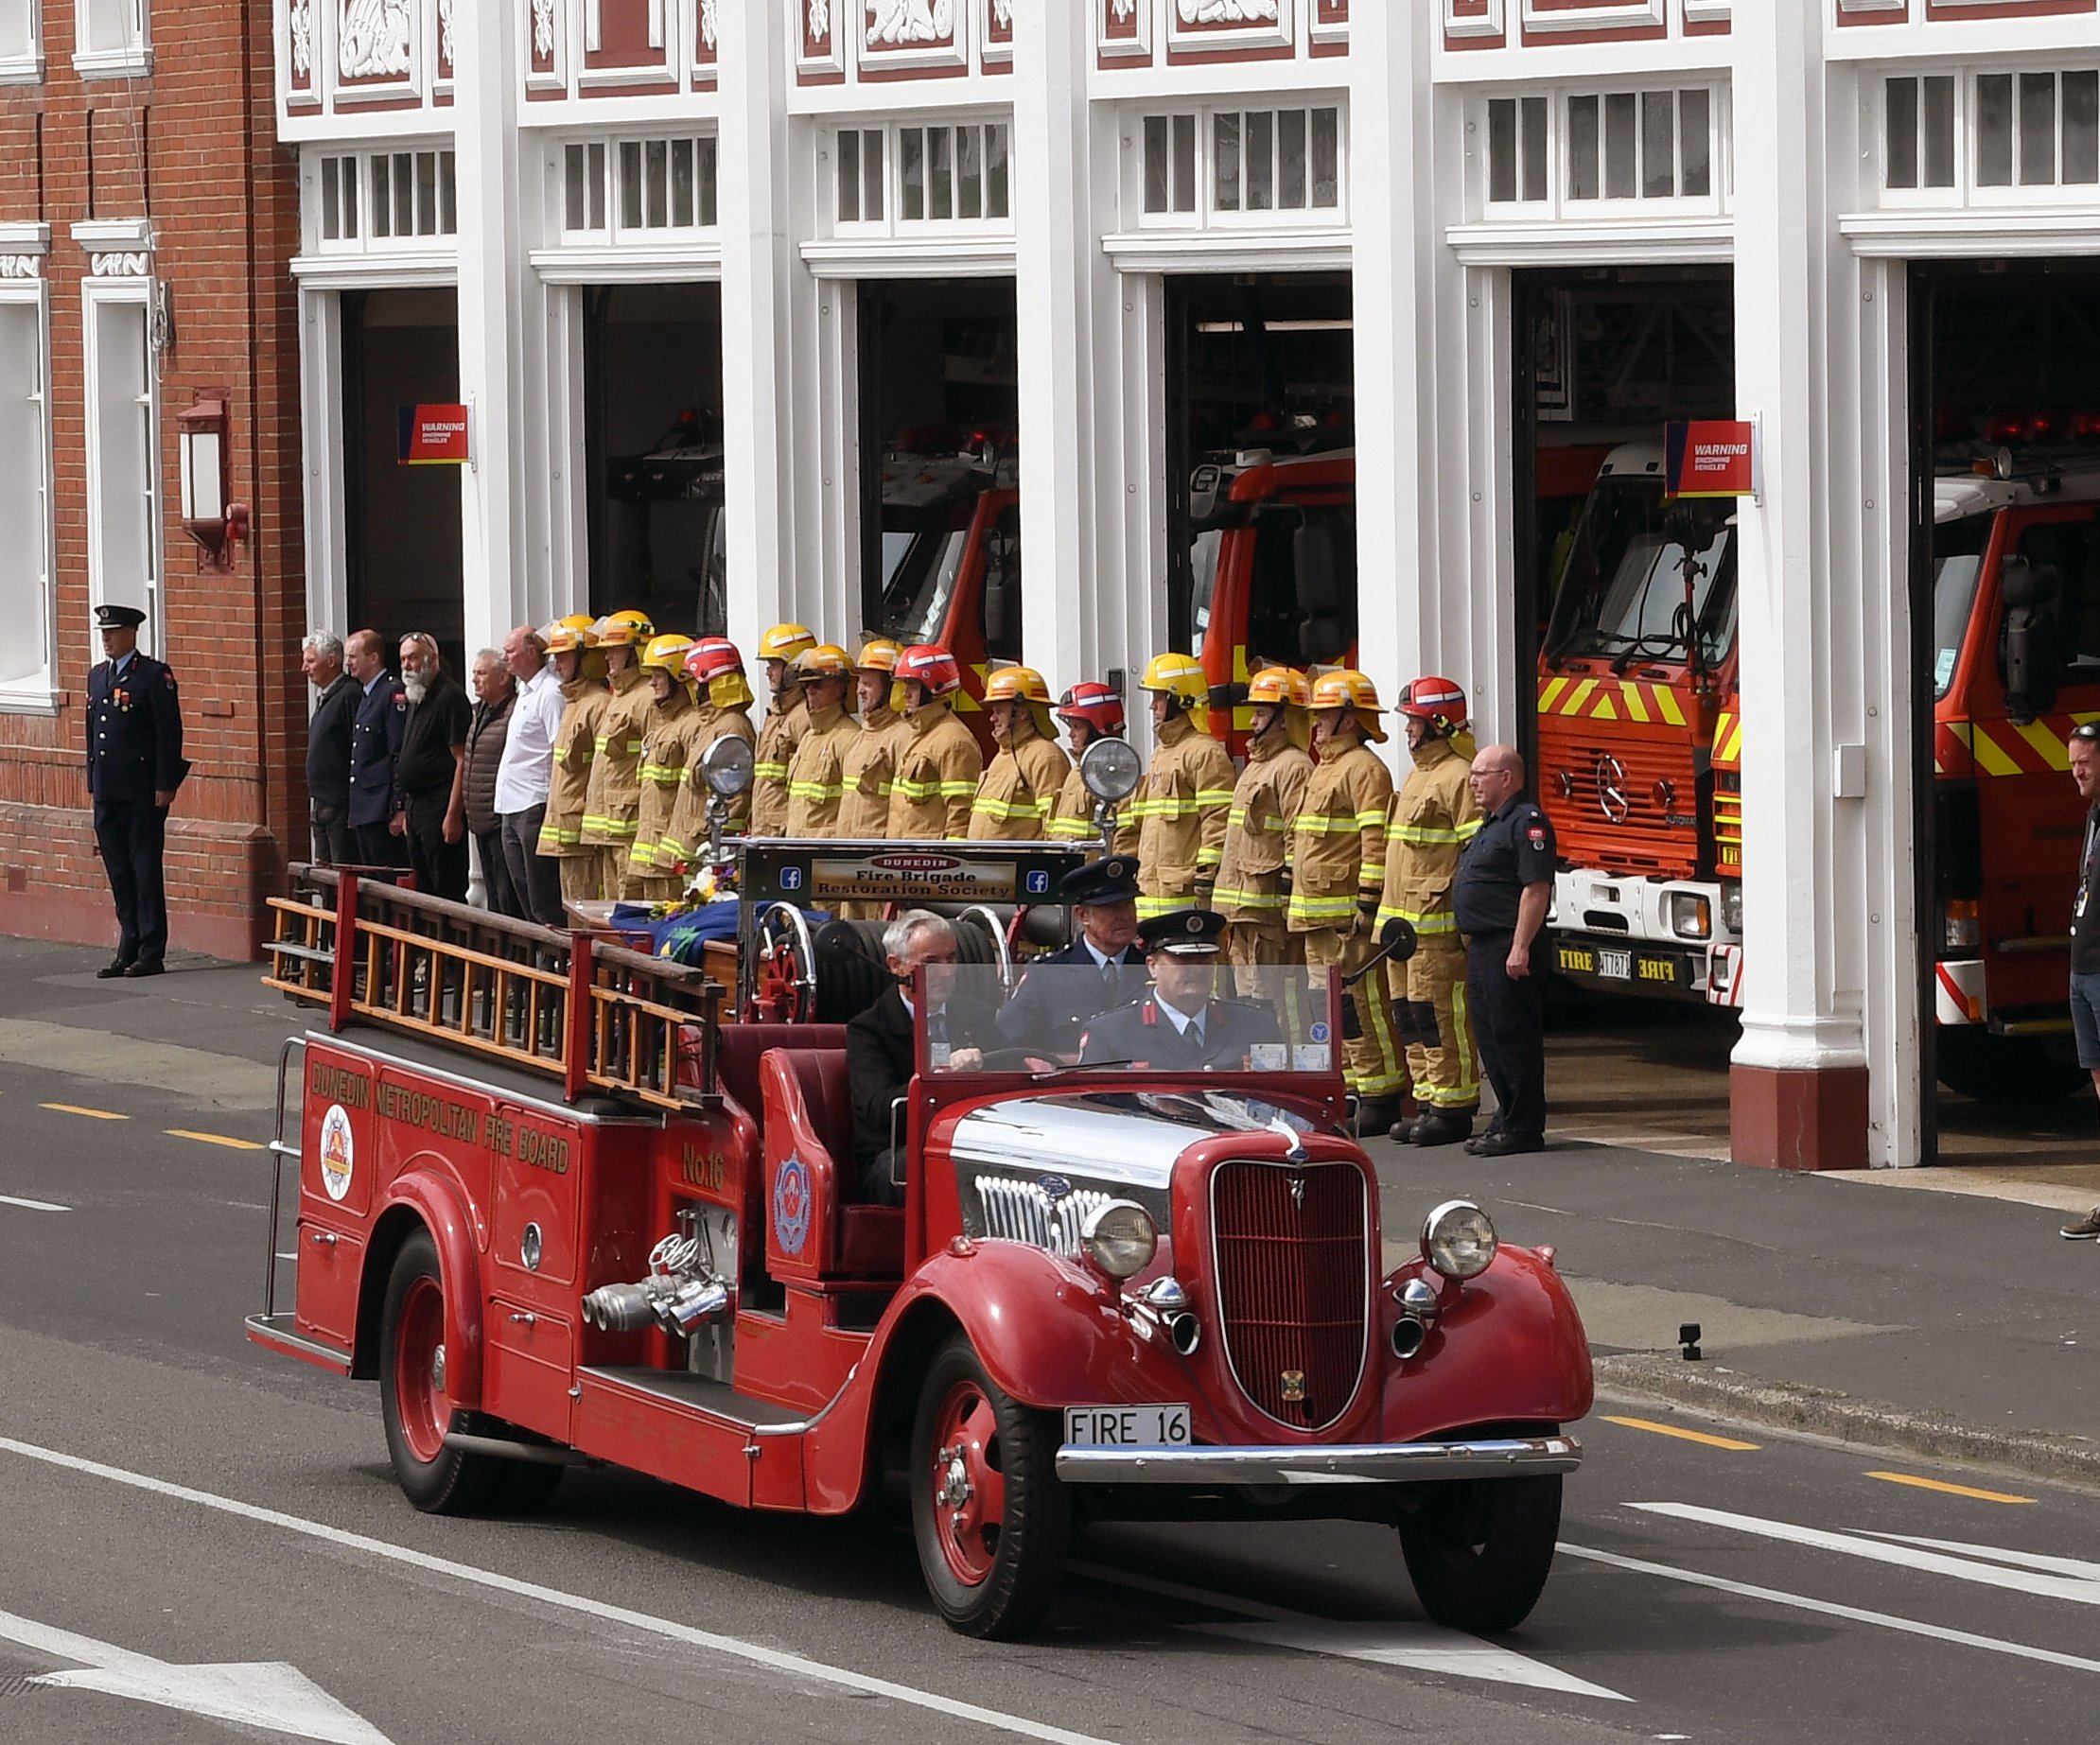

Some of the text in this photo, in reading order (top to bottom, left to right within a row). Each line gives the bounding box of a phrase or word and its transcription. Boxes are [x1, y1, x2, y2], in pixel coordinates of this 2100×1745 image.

[422, 423, 464, 431] WARNING
[1695, 444, 1748, 455] WARNING
[883, 858, 948, 867] DUNEDIN
[856, 870, 976, 884] Fire Brigade
[817, 883, 1009, 899] Restoration Society
[1559, 949, 1593, 971] FIRE
[312, 1061, 569, 1174] DUNEDIN METROPOLITAN FIRE BOARD
[683, 1142, 724, 1191] No.16
[1071, 1411, 1186, 1444] FIRE 16
